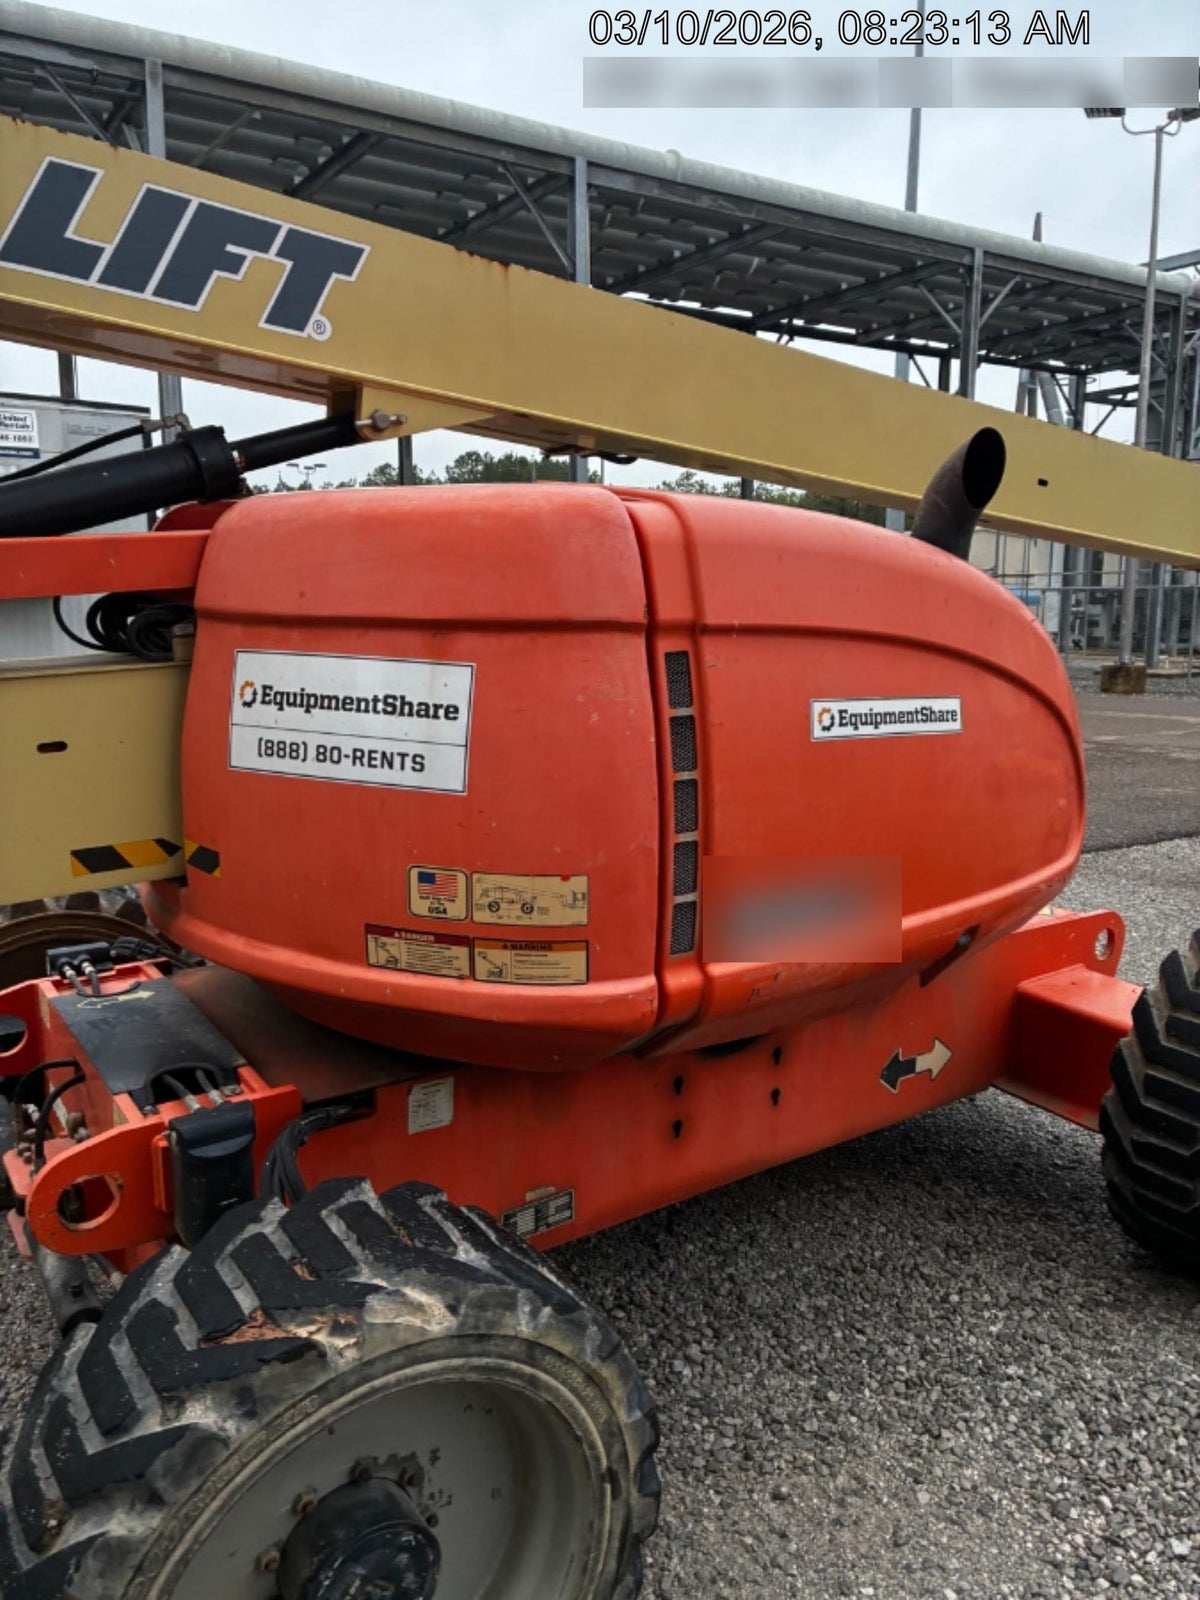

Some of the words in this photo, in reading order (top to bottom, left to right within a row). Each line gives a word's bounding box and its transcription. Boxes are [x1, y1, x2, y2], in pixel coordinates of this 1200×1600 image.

[0, 155, 372, 338] LIFT
[260, 684, 460, 721] EquipmentShare
[837, 706, 958, 731] EquipmentShare
[257, 737, 308, 763] (888)
[315, 744, 426, 773] 80-RENTS
[511, 943, 554, 951] WARNING
